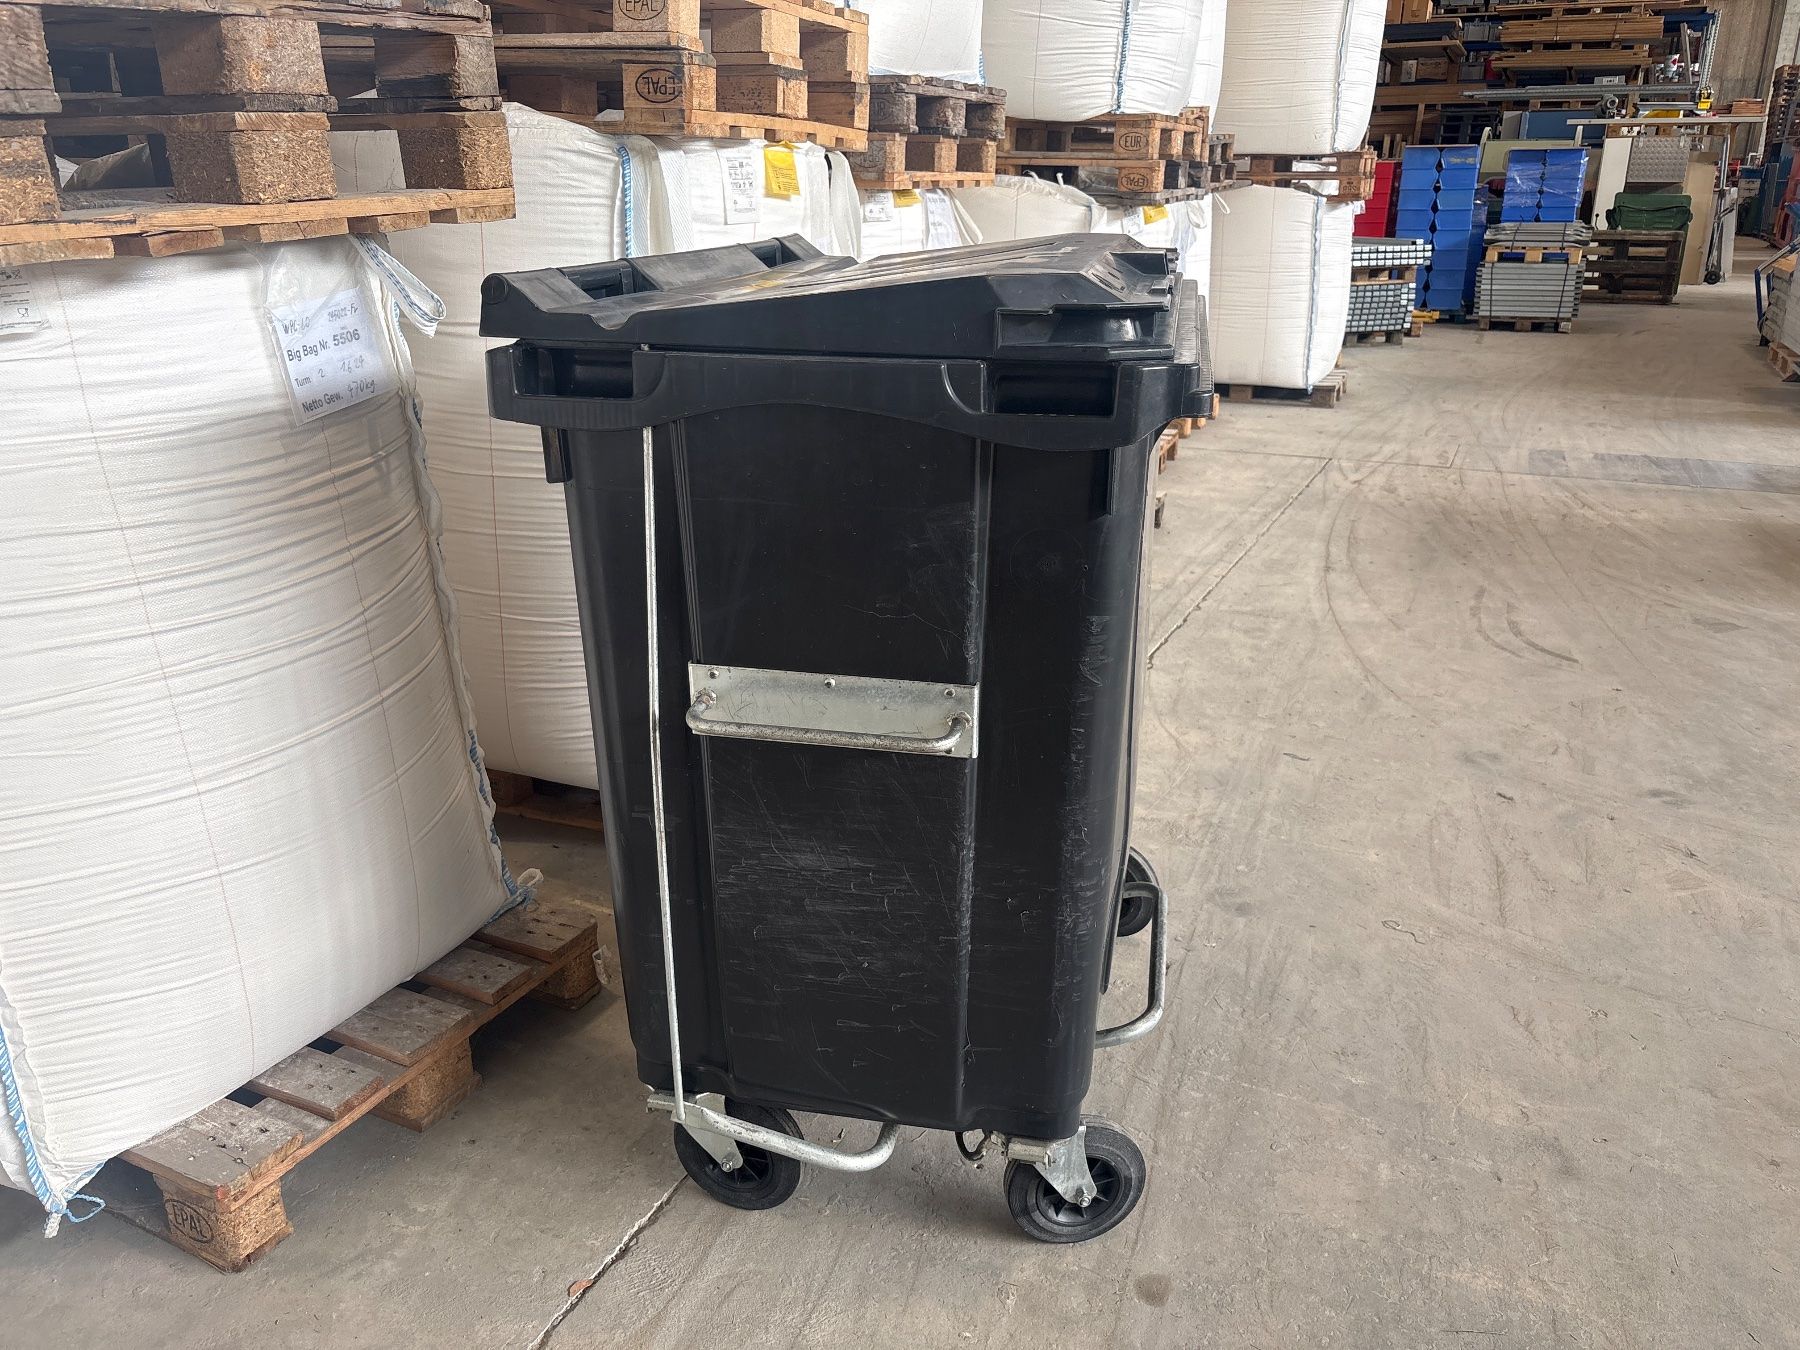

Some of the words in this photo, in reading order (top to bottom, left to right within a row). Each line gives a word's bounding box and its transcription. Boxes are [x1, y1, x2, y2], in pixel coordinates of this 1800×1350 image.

[625, 0, 658, 12] EPAL
[642, 76, 676, 95] EPAL
[1124, 135, 1142, 148] EUR
[1124, 176, 1145, 187] EPAL
[287, 349, 302, 362] Big
[302, 344, 319, 357] Bag
[318, 339, 331, 350] Nr.
[332, 328, 361, 347] 5506
[301, 396, 324, 414] Netto
[324, 391, 344, 406] Gew.
[172, 1203, 208, 1240] EPAL
